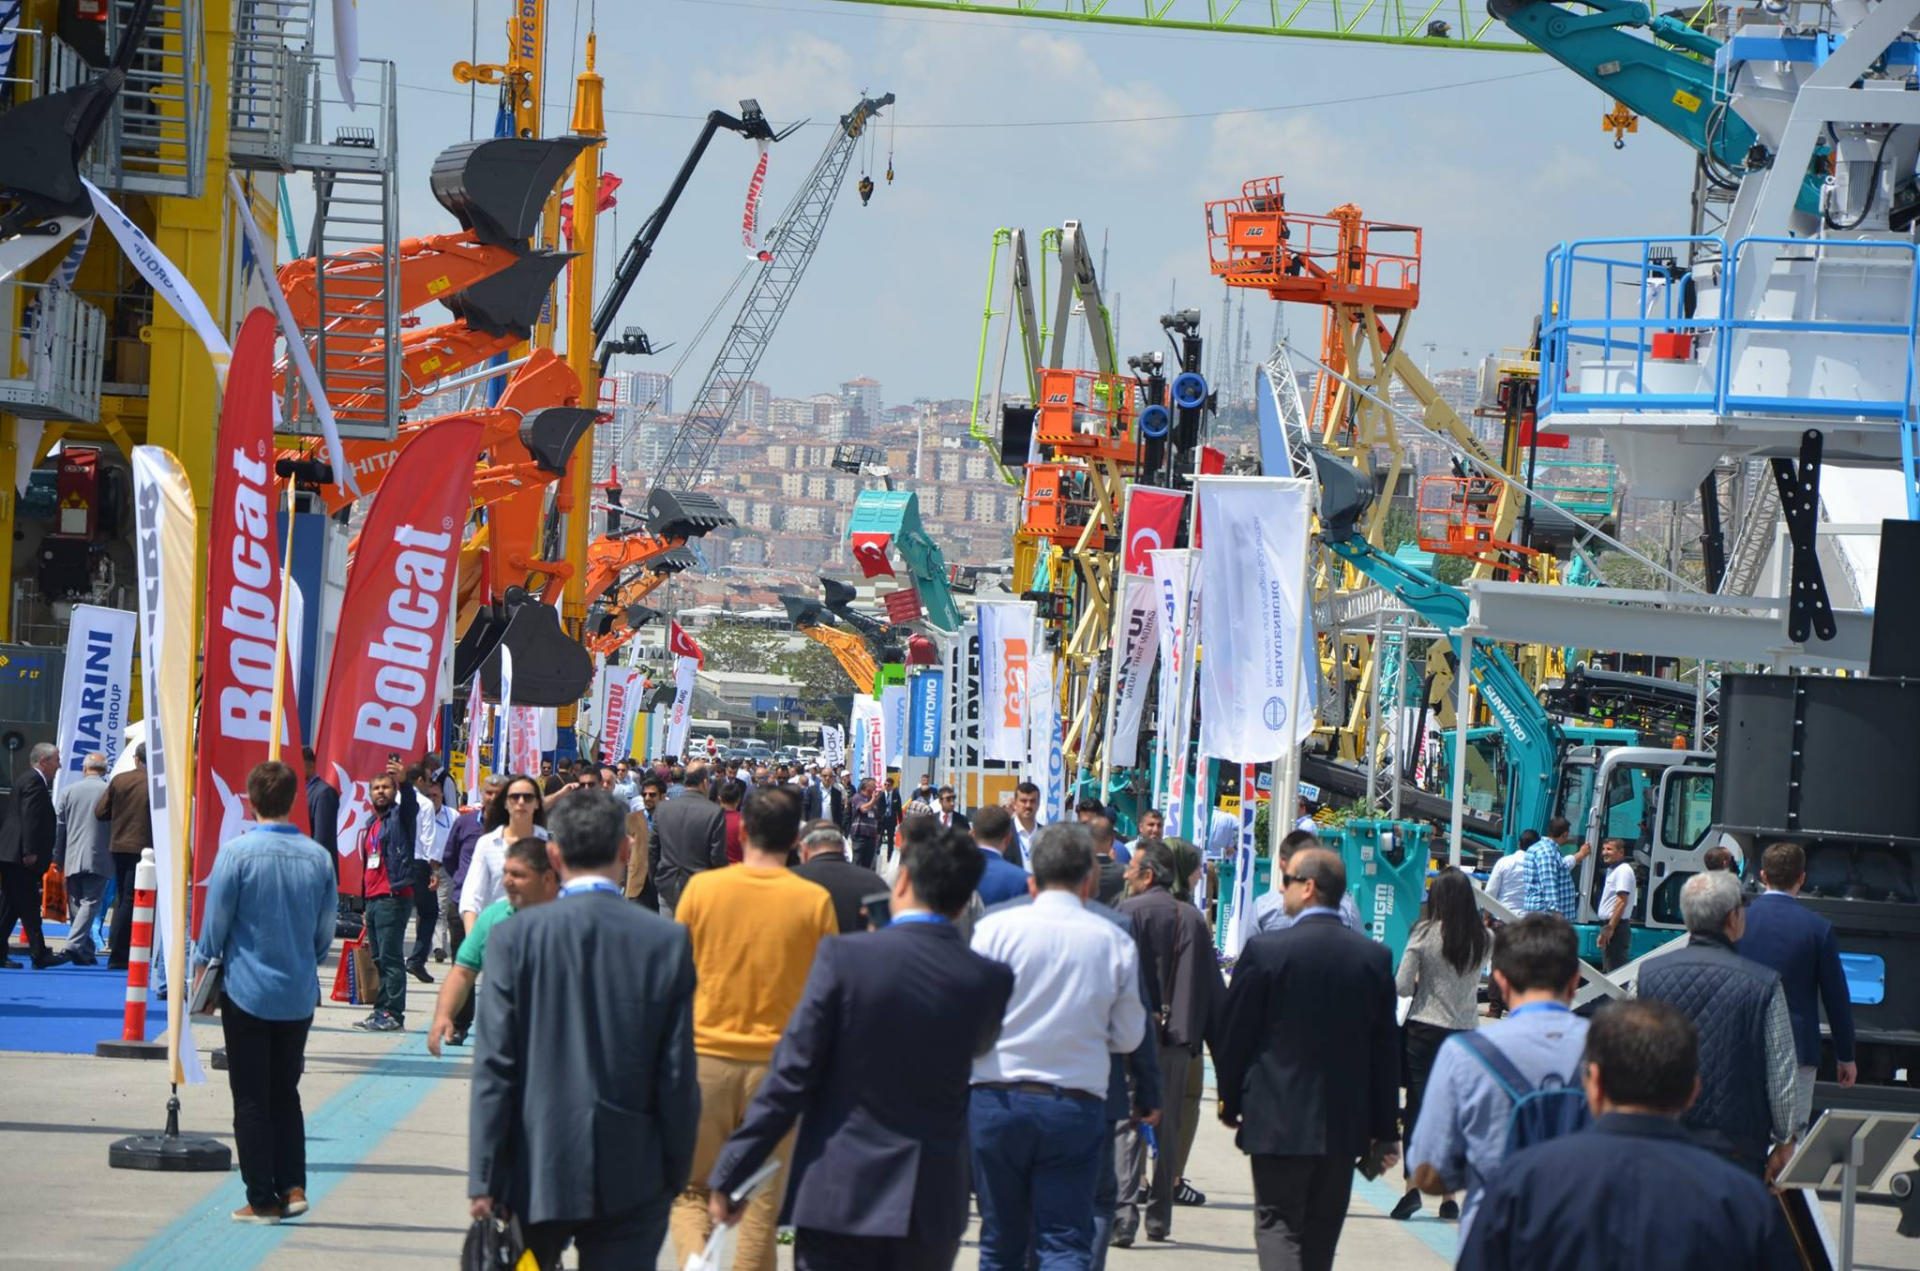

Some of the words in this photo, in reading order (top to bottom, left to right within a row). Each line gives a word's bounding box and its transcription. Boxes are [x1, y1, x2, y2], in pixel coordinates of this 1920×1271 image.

[1246, 226, 1264, 236] JLG
[1048, 393, 1067, 403] JLG
[1035, 488, 1052, 497] JLG
[220, 447, 289, 746] Bobcat
[353, 523, 451, 750] Bobcat
[1124, 669, 1138, 699] VALUE
[1133, 643, 1145, 667] THAT
[70, 630, 113, 772] MARINI
[108, 684, 122, 730] GROUP
[603, 683, 625, 765] MANITOU
[923, 678, 937, 753] SUMITOMO
[1483, 684, 1526, 741] SUNWARD
